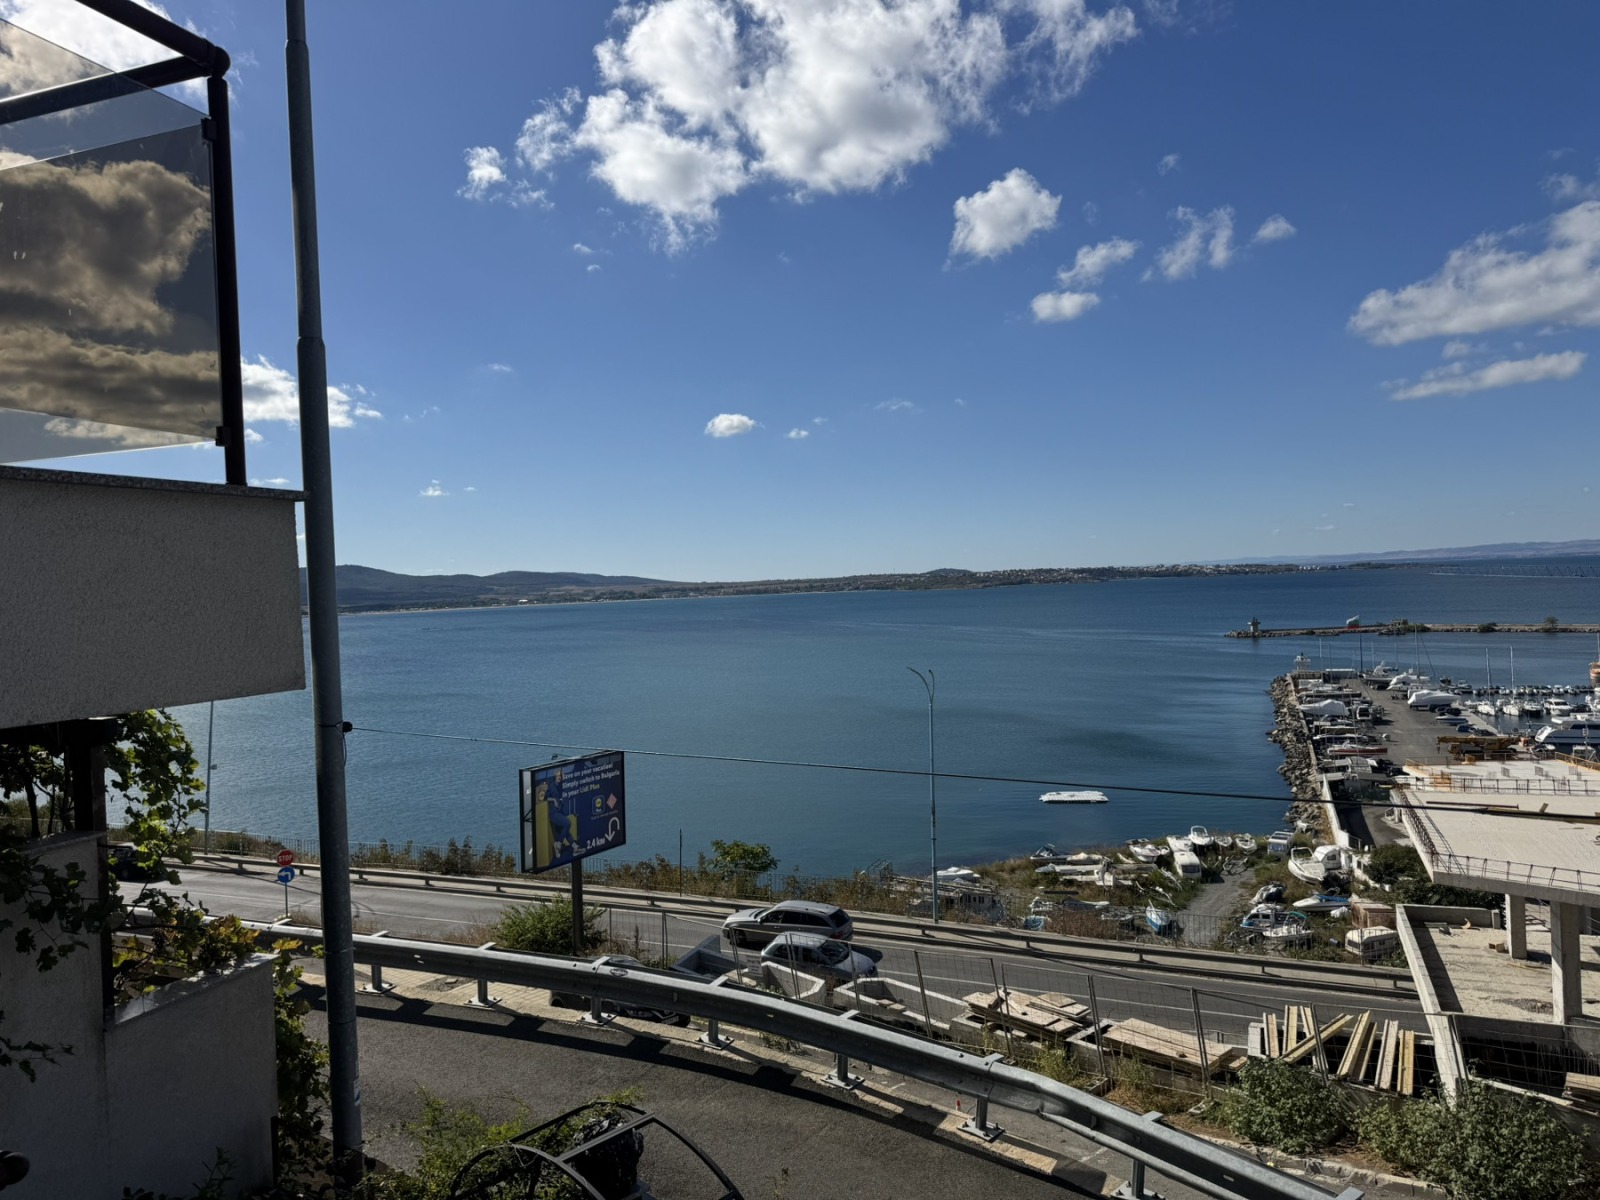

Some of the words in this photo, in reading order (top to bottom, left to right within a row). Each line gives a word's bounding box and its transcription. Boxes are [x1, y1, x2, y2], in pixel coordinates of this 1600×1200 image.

[581, 768, 592, 777] your
[562, 780, 579, 789] Simply
[579, 775, 595, 785] switch
[601, 770, 620, 780] Bulgaria
[568, 789, 579, 798] your
[586, 838, 595, 849] 2.4
[596, 837, 605, 846] km
[278, 854, 293, 862] STOP
